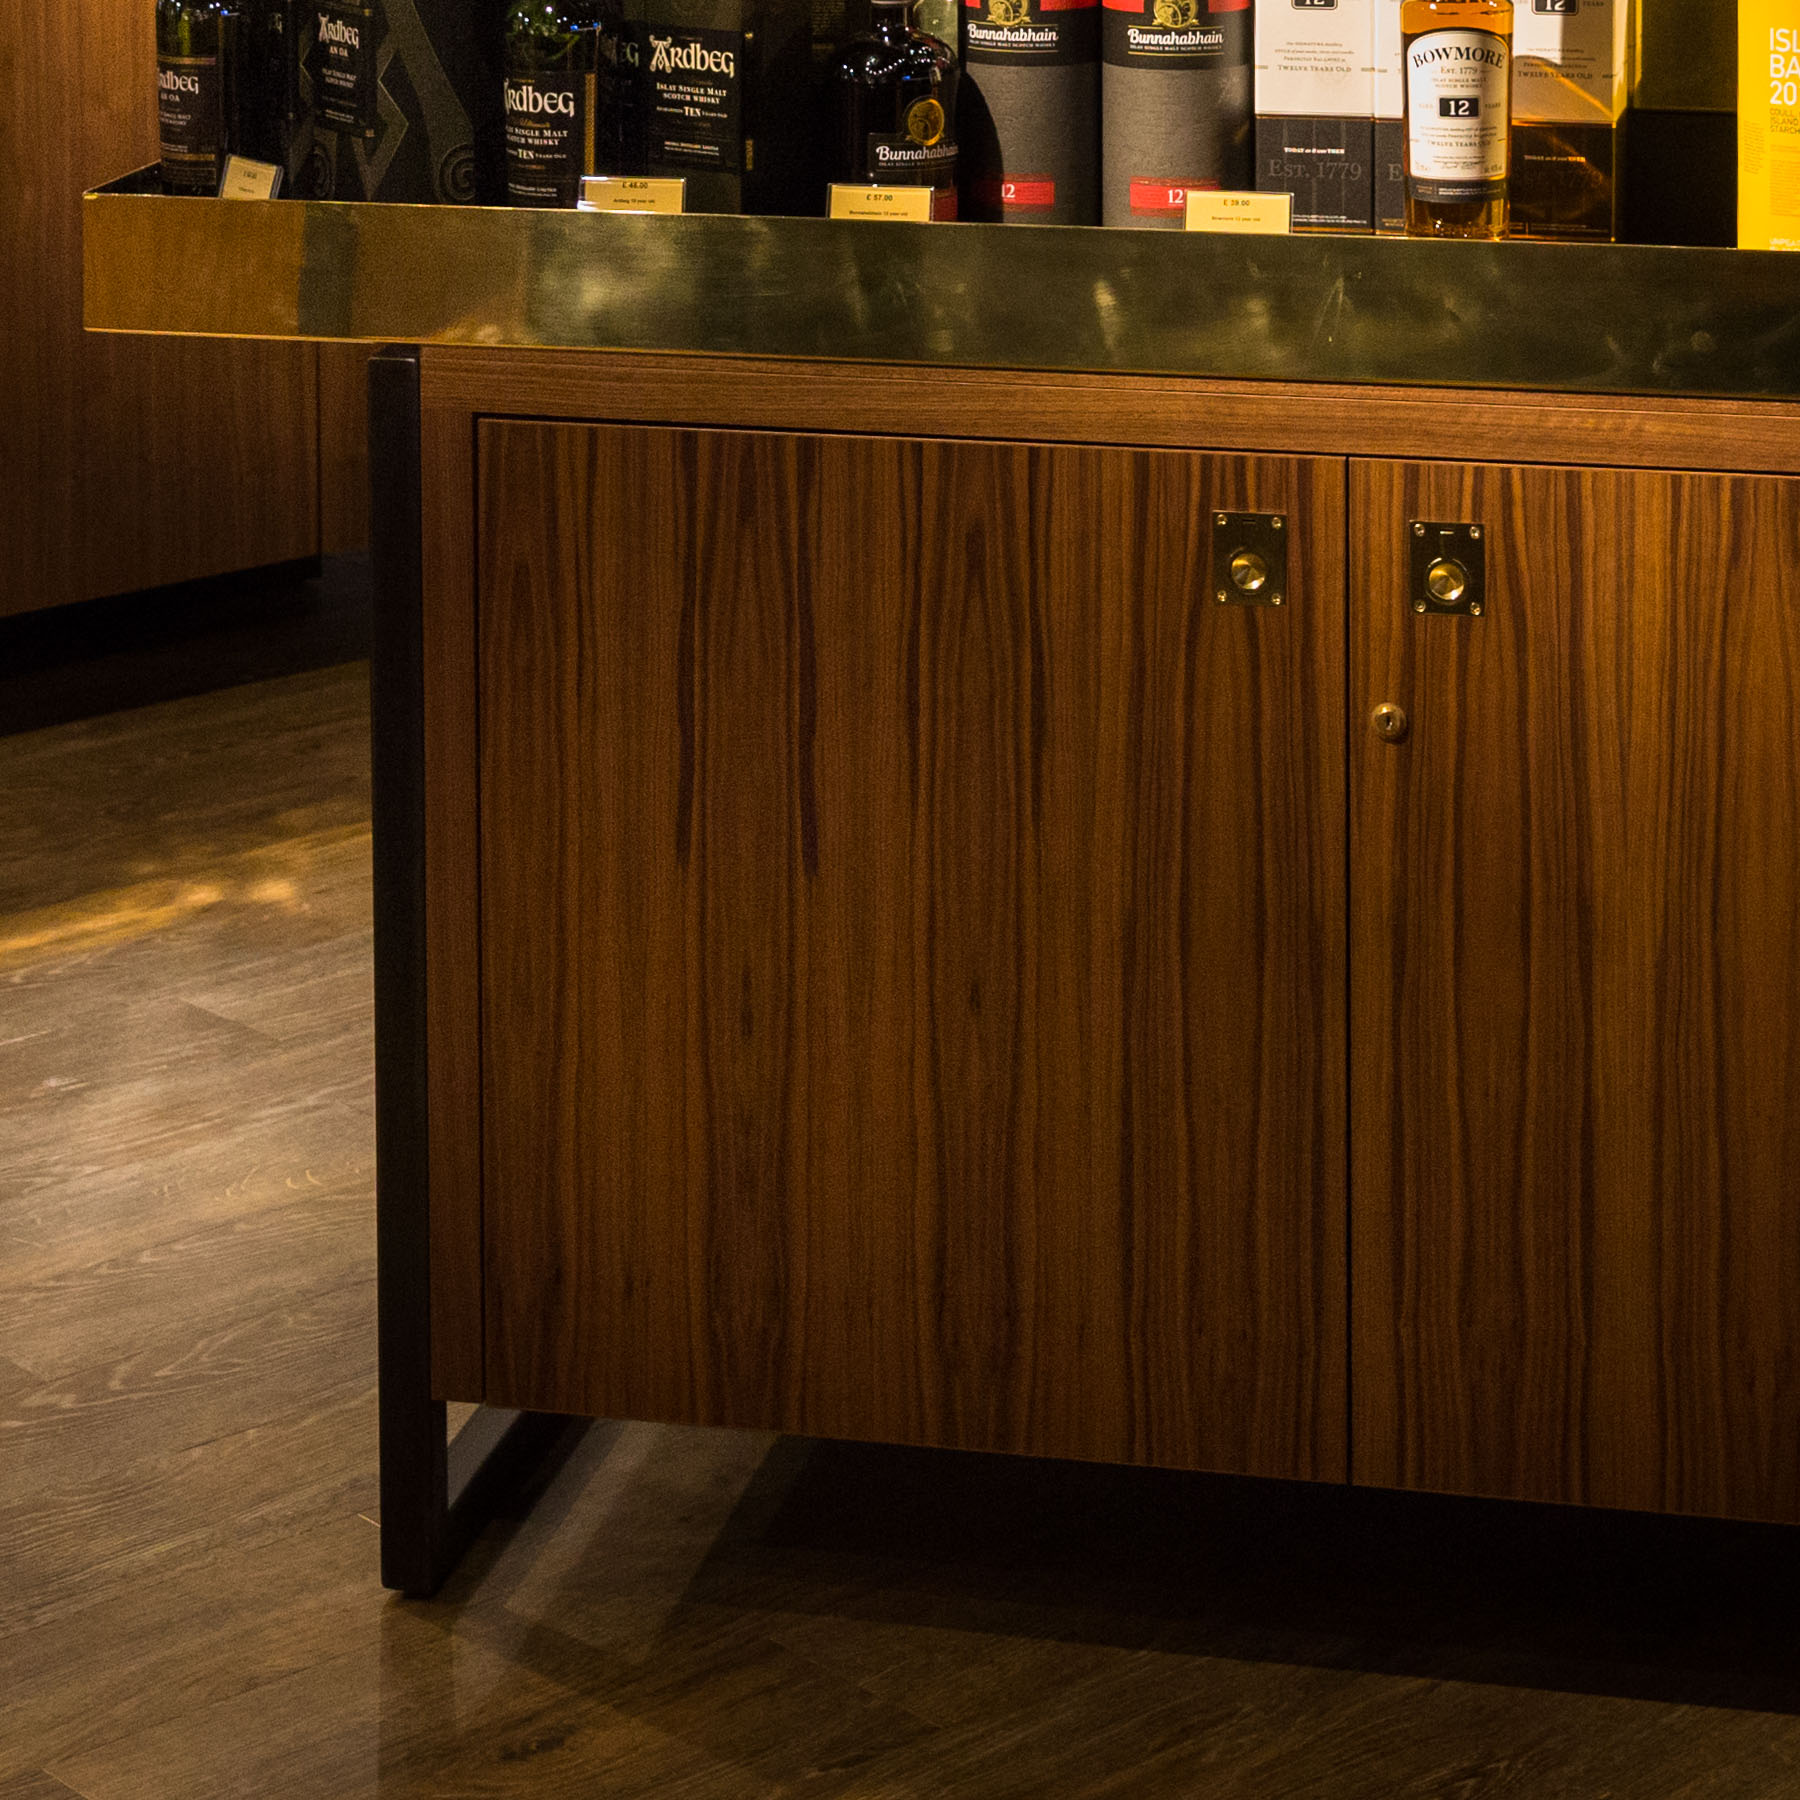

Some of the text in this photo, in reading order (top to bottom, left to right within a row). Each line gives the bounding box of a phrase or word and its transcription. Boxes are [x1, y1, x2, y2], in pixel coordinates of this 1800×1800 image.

[967, 21, 1059, 43] Bunnahabhain
[1126, 27, 1225, 47] Bunnahabhain
[1413, 46, 1504, 68] BOWMORE
[656, 82, 728, 97] ISLAY SINGLE MALT
[663, 92, 721, 104] SCOTCH WHISKY
[683, 106, 702, 117] TEN
[1449, 100, 1470, 116] 12
[514, 128, 569, 137] SINGLE MALT
[527, 136, 560, 146] WHISKY
[517, 148, 535, 159] TEN
[1268, 159, 1362, 180] Est. 1779
[1167, 189, 1184, 204] 12
